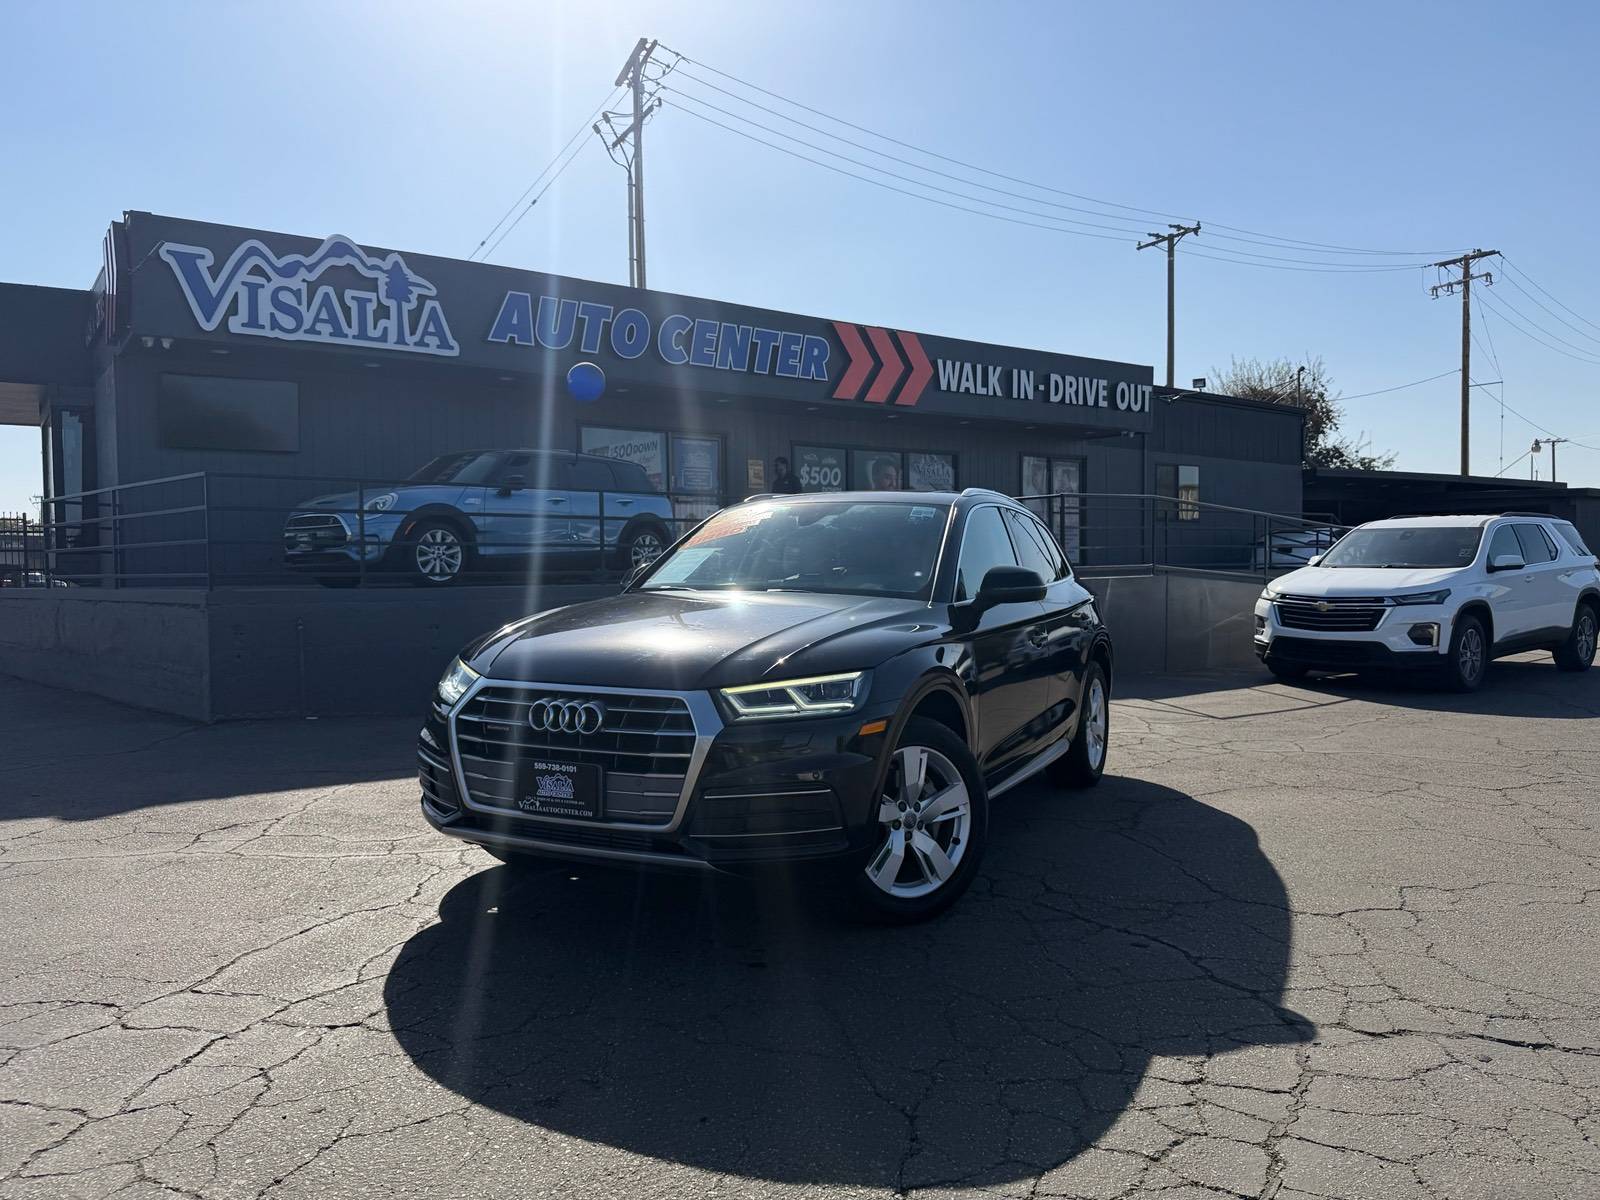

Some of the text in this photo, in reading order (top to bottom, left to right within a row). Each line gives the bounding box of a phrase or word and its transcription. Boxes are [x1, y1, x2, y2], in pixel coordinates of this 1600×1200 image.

[160, 240, 830, 381] VISALIA AUTO CENTER
[937, 358, 1003, 396] WALK
[1115, 381, 1152, 412] OUT
[800, 463, 841, 487] $500
[534, 762, 577, 773] 559-738-0101
